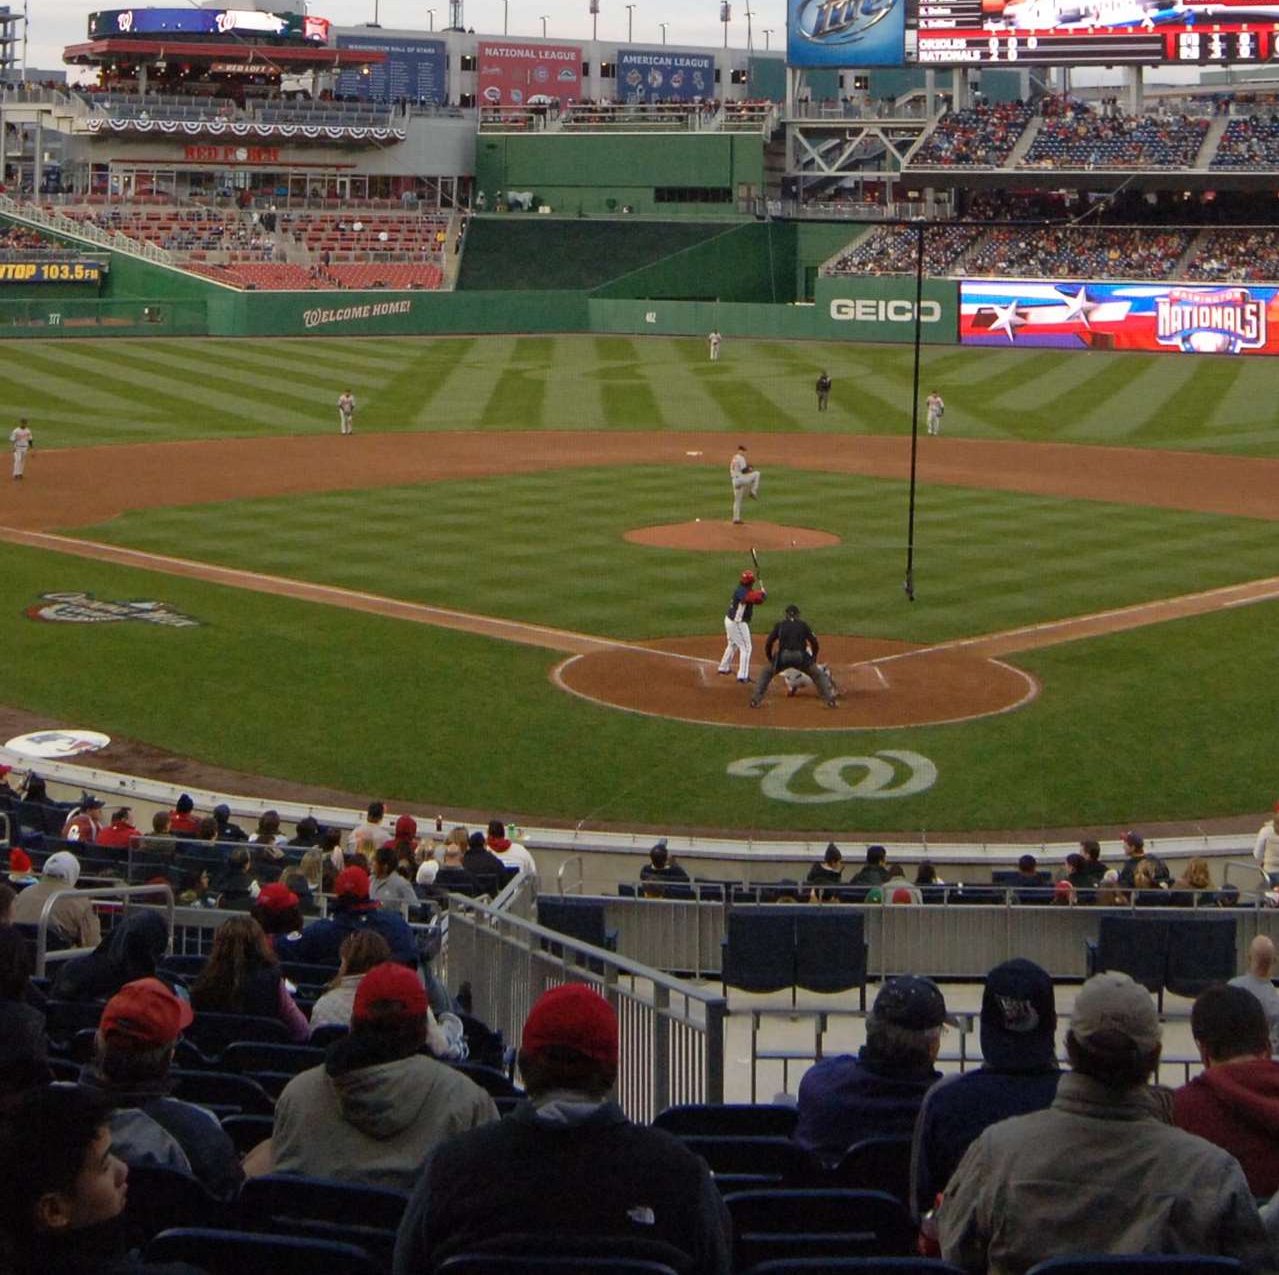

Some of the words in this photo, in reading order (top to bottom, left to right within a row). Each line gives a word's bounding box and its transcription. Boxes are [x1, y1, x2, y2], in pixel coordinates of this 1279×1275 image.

[485, 47, 537, 59] NATIONAL
[538, 49, 576, 61] LEAGUE
[623, 55, 671, 66] AMERICAN
[673, 57, 710, 68] LEAGUE
[184, 147, 217, 160] RED
[303, 305, 370, 327] WELCOME
[372, 300, 410, 315] HOME!
[830, 299, 942, 323] GEICO
[1158, 301, 1258, 338] NATIONALS
